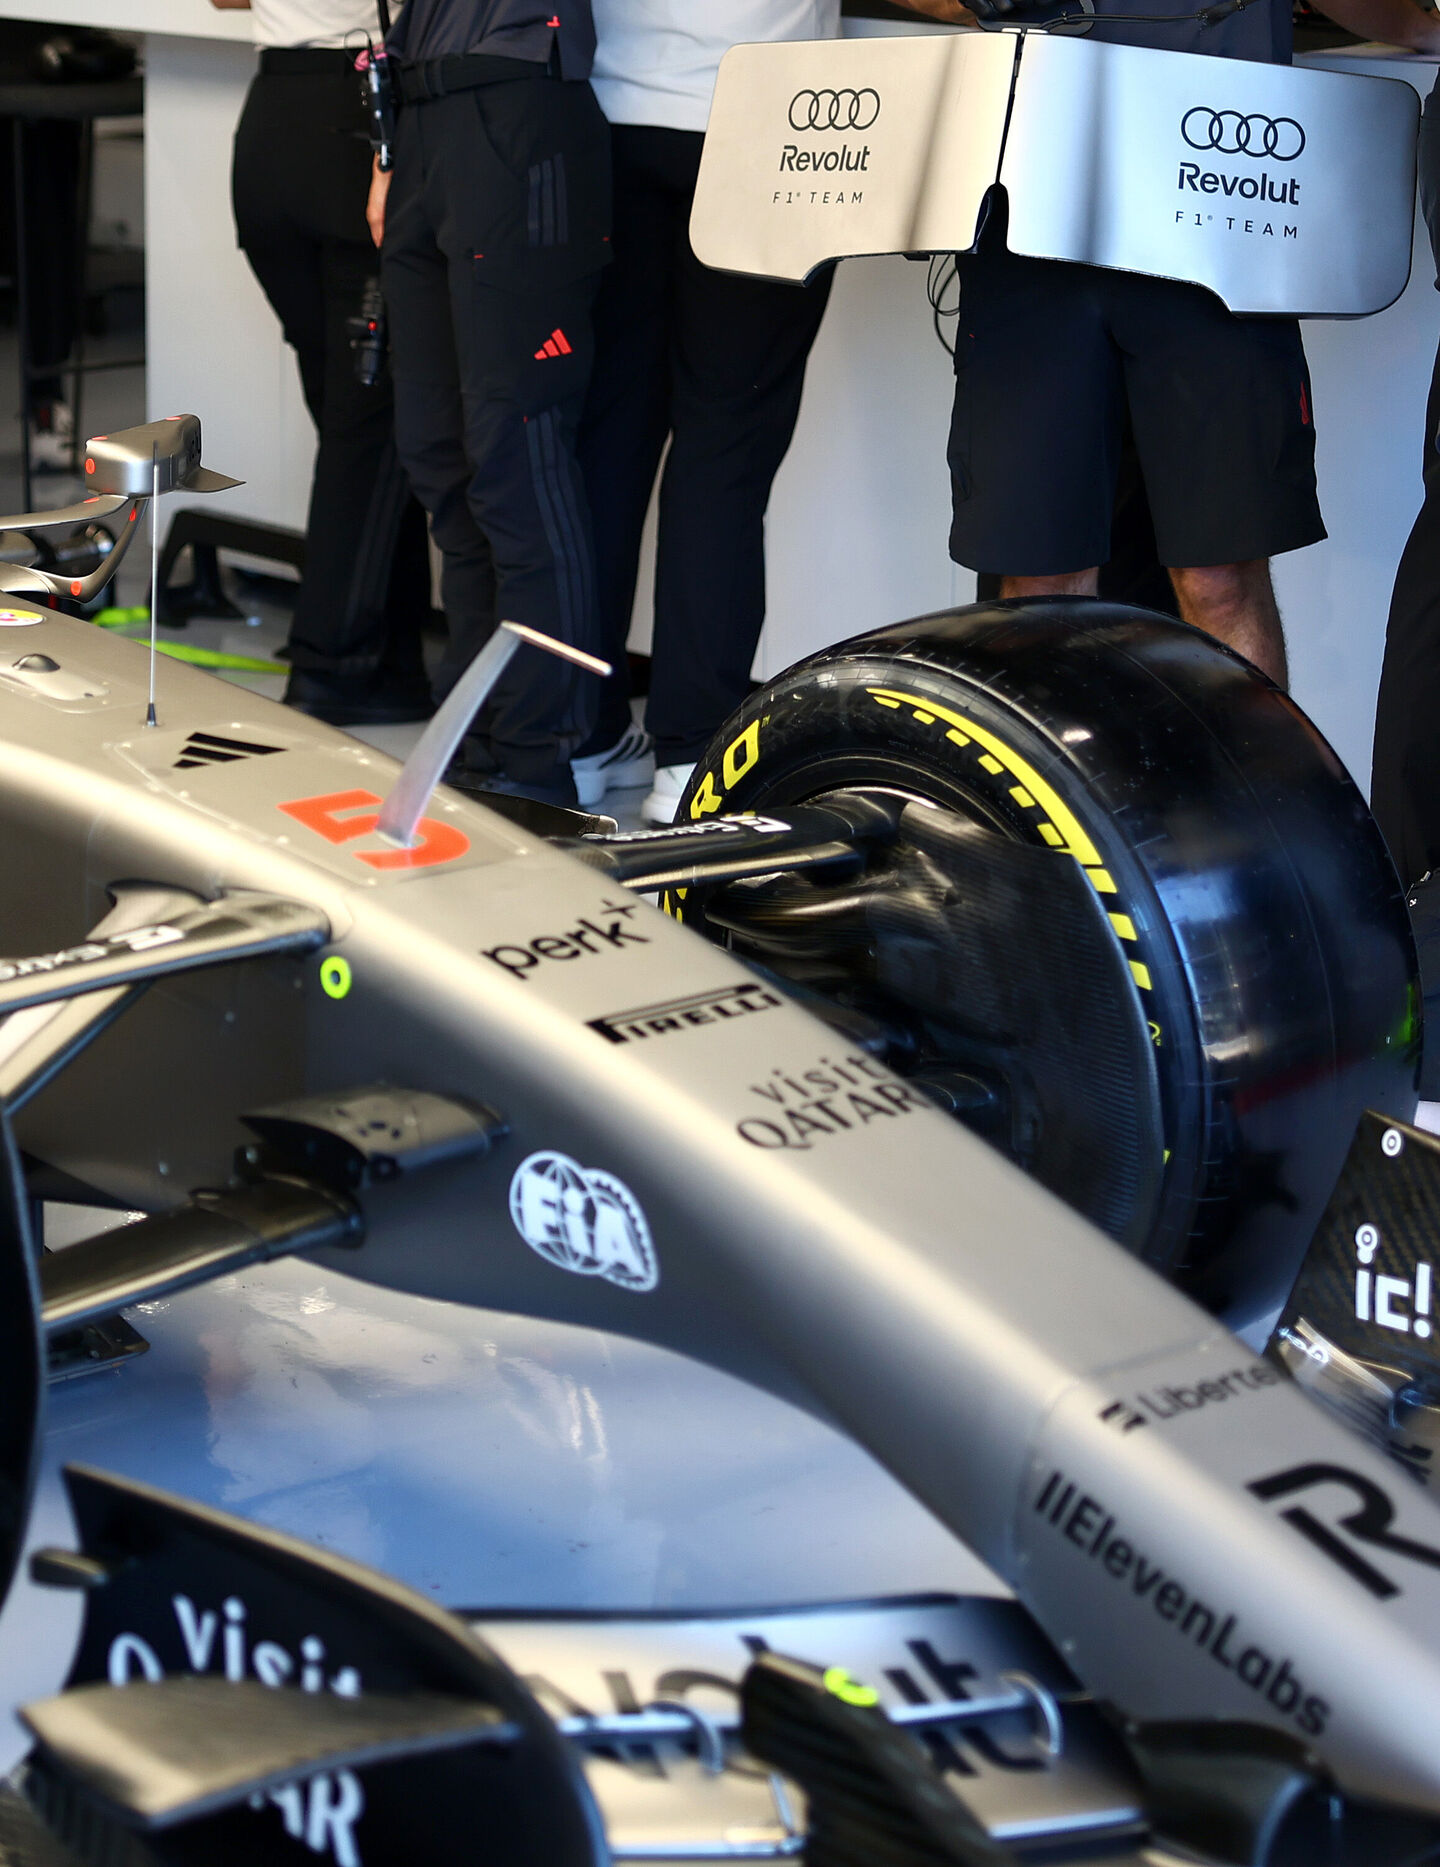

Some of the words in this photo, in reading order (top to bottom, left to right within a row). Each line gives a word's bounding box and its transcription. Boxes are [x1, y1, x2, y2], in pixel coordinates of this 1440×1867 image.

[779, 144, 870, 172] Revolut
[810, 191, 863, 204] TEAM
[1178, 161, 1300, 206] Revolut
[1225, 216, 1298, 239] TEAM
[276, 788, 472, 871] 5
[585, 982, 786, 1045] PIRELLI
[748, 1055, 890, 1106] visit
[735, 1081, 934, 1152] QATAR
